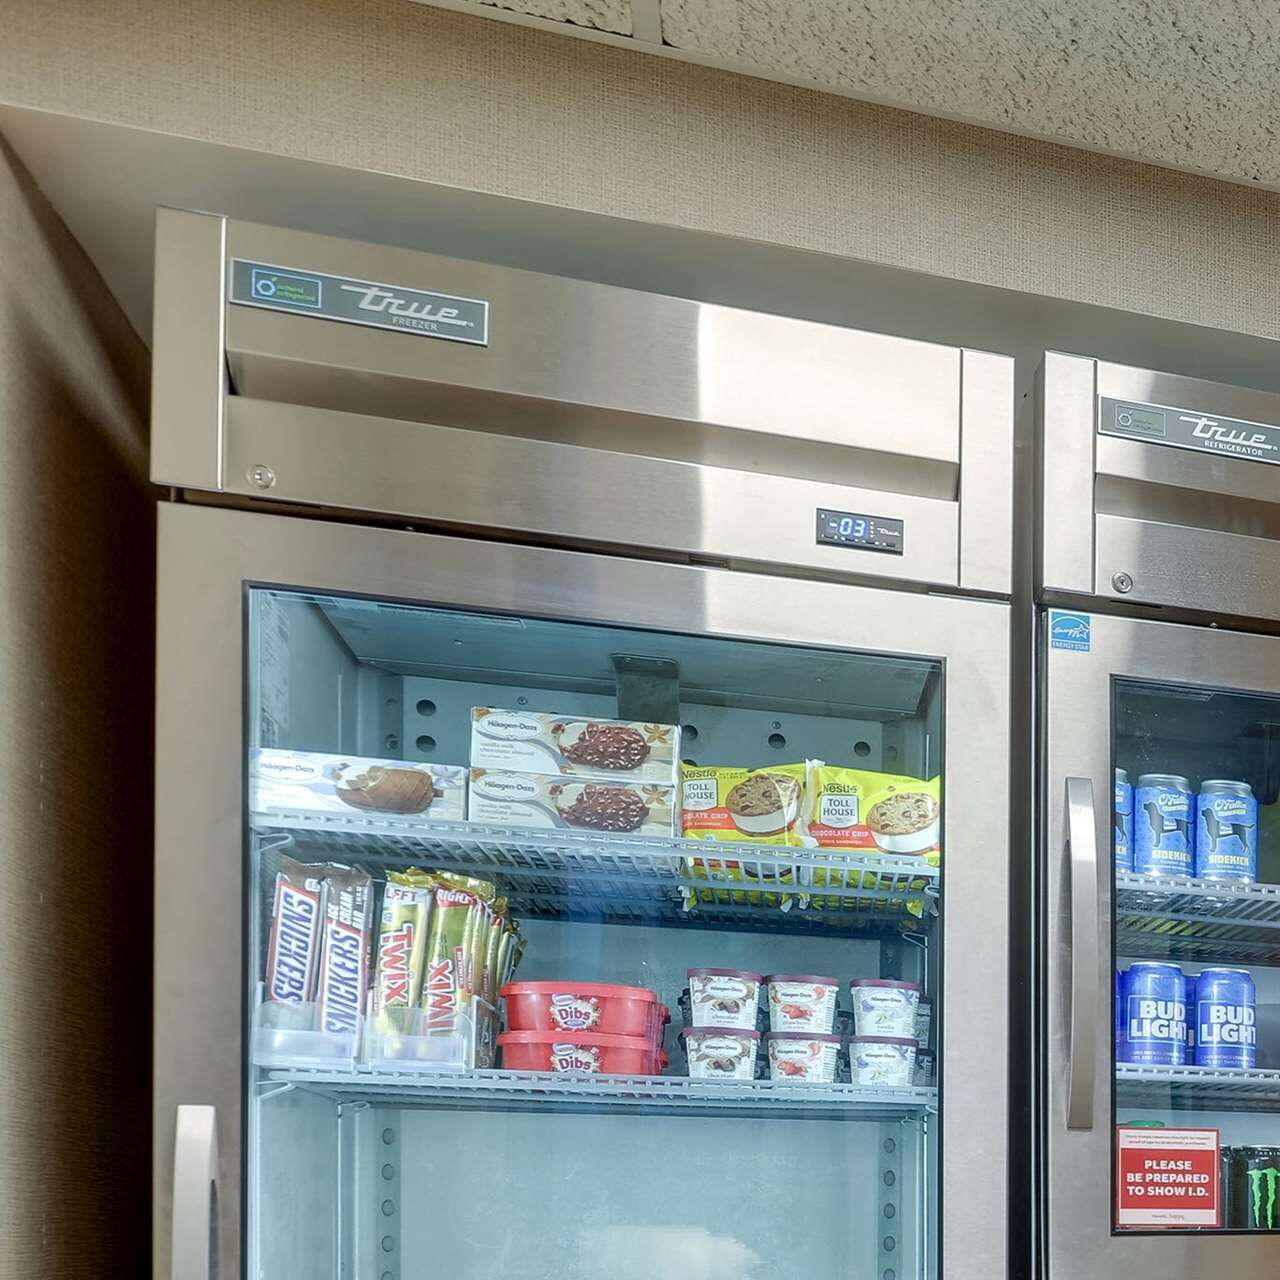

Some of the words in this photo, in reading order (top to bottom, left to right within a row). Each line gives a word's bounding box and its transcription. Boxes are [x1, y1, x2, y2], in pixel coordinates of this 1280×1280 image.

[392, 317, 437, 331] FREEZER
[1204, 440, 1263, 457] REFRIGERATOR
[687, 783, 710, 792] TOLL
[684, 791, 715, 801] HOUSE
[828, 798, 850, 809] TOLL
[823, 807, 855, 817] HOUSE
[380, 923, 414, 1008] TWIX
[325, 928, 360, 1035] SNICKERS
[427, 959, 455, 1032] TWIX
[558, 1006, 593, 1022] Dibs
[1140, 1001, 1186, 1021] BUD
[1209, 1005, 1255, 1024] BUD
[558, 1056, 593, 1073] Dibs
[1144, 1160, 1193, 1170] PLEASE
[1126, 1172, 1143, 1183] BE
[1145, 1173, 1210, 1184] PREPARED
[1127, 1185, 1145, 1196] TO
[1147, 1186, 1185, 1197] SHOW
[1188, 1187, 1209, 1197] I.D.
